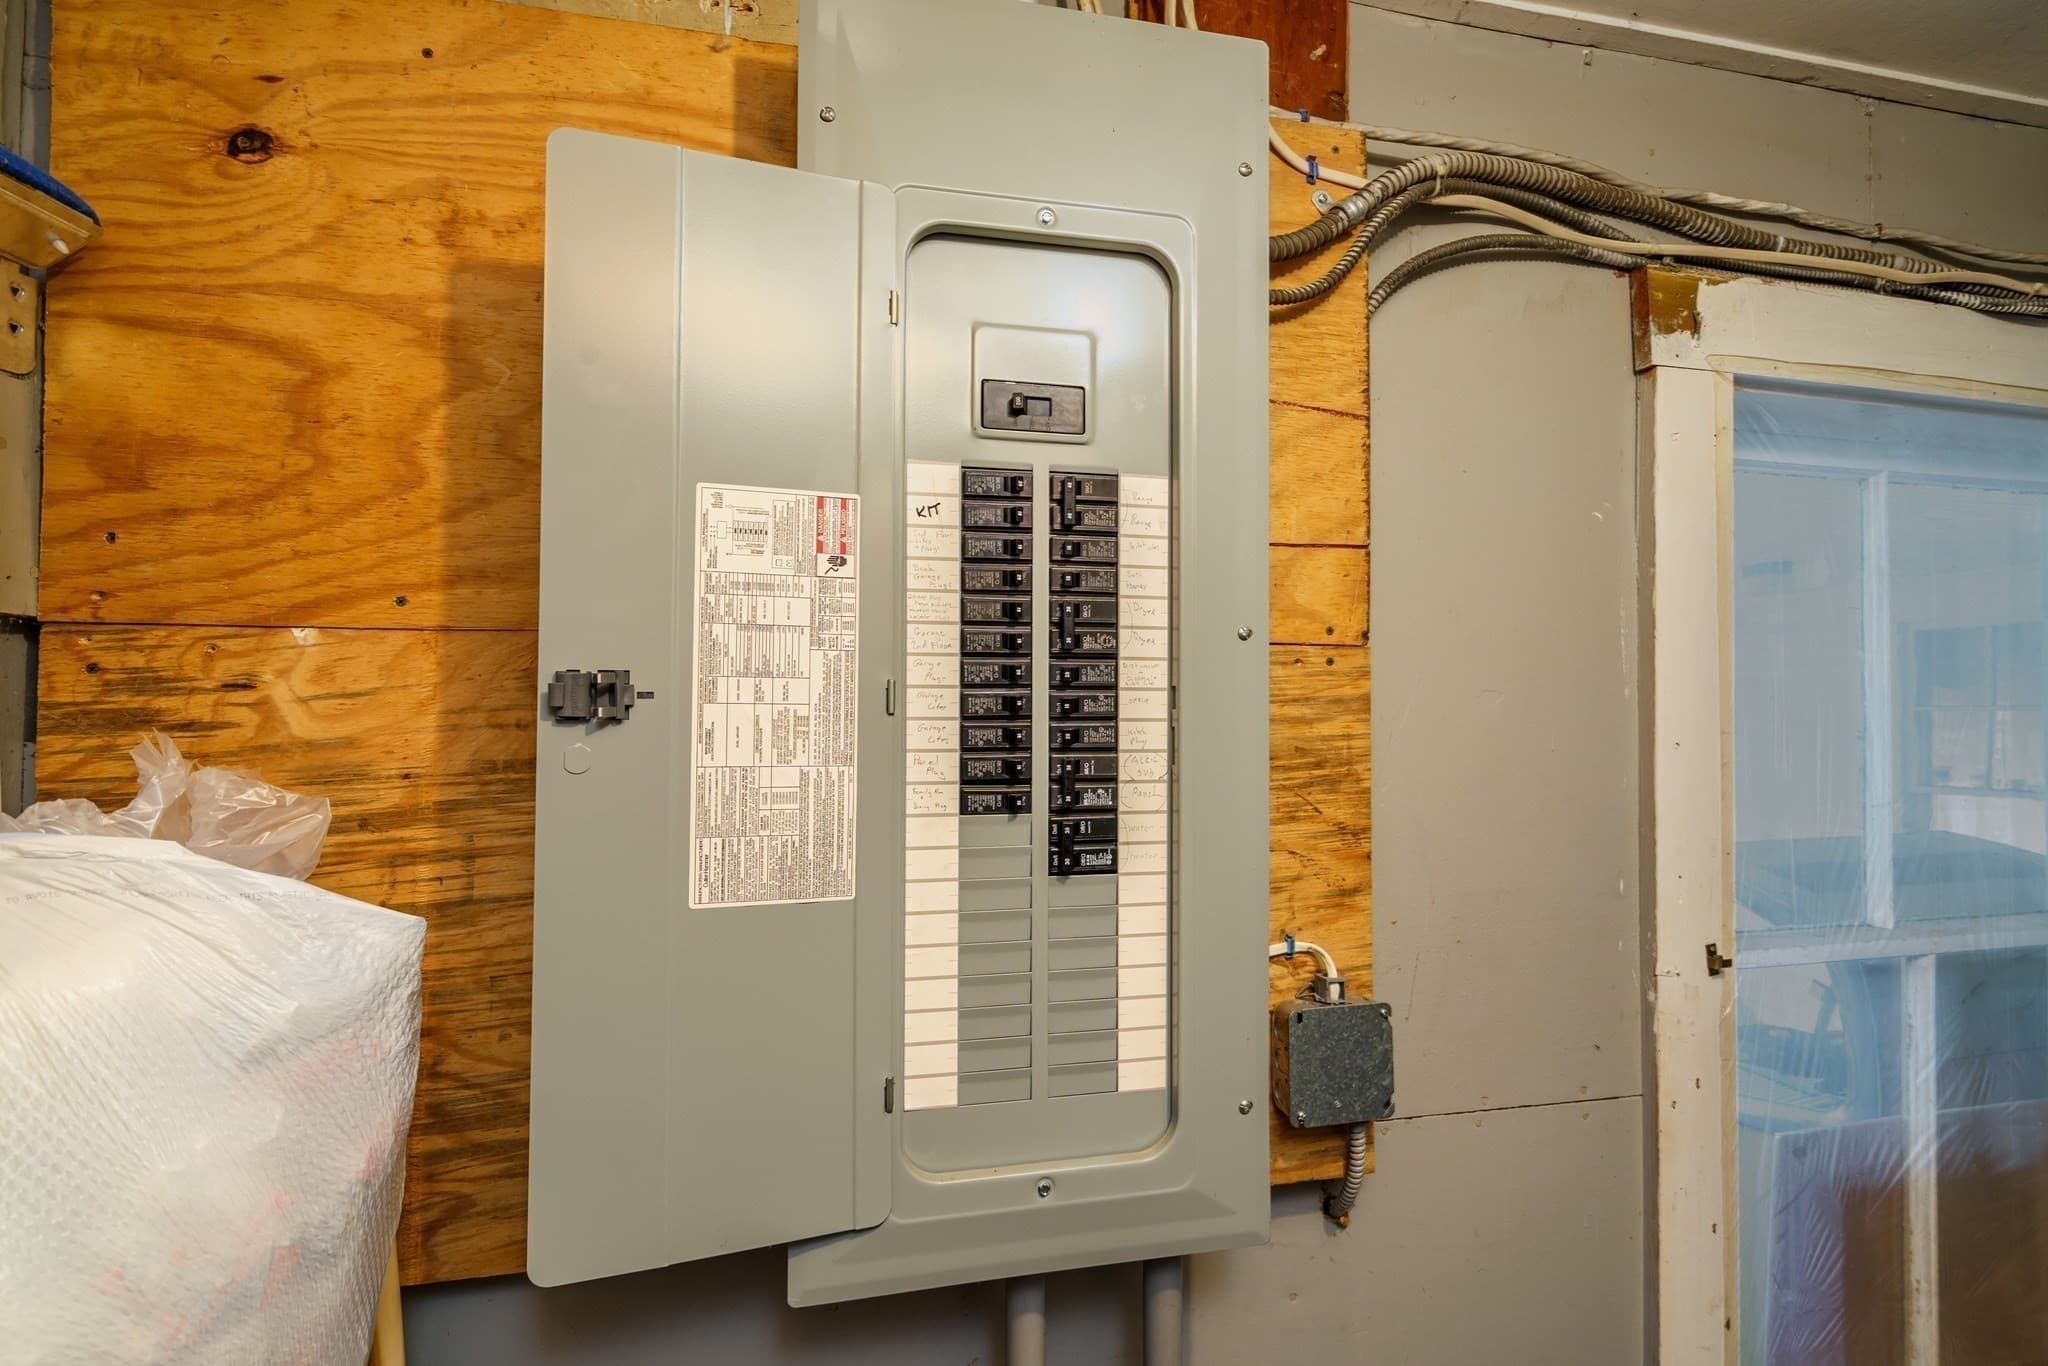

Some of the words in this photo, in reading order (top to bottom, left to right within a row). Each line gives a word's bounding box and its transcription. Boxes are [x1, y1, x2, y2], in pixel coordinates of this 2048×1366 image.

[915, 502, 942, 518] KIT
[1130, 512, 1152, 530] Range
[913, 626, 946, 642] Garage
[917, 722, 947, 734] Garage
